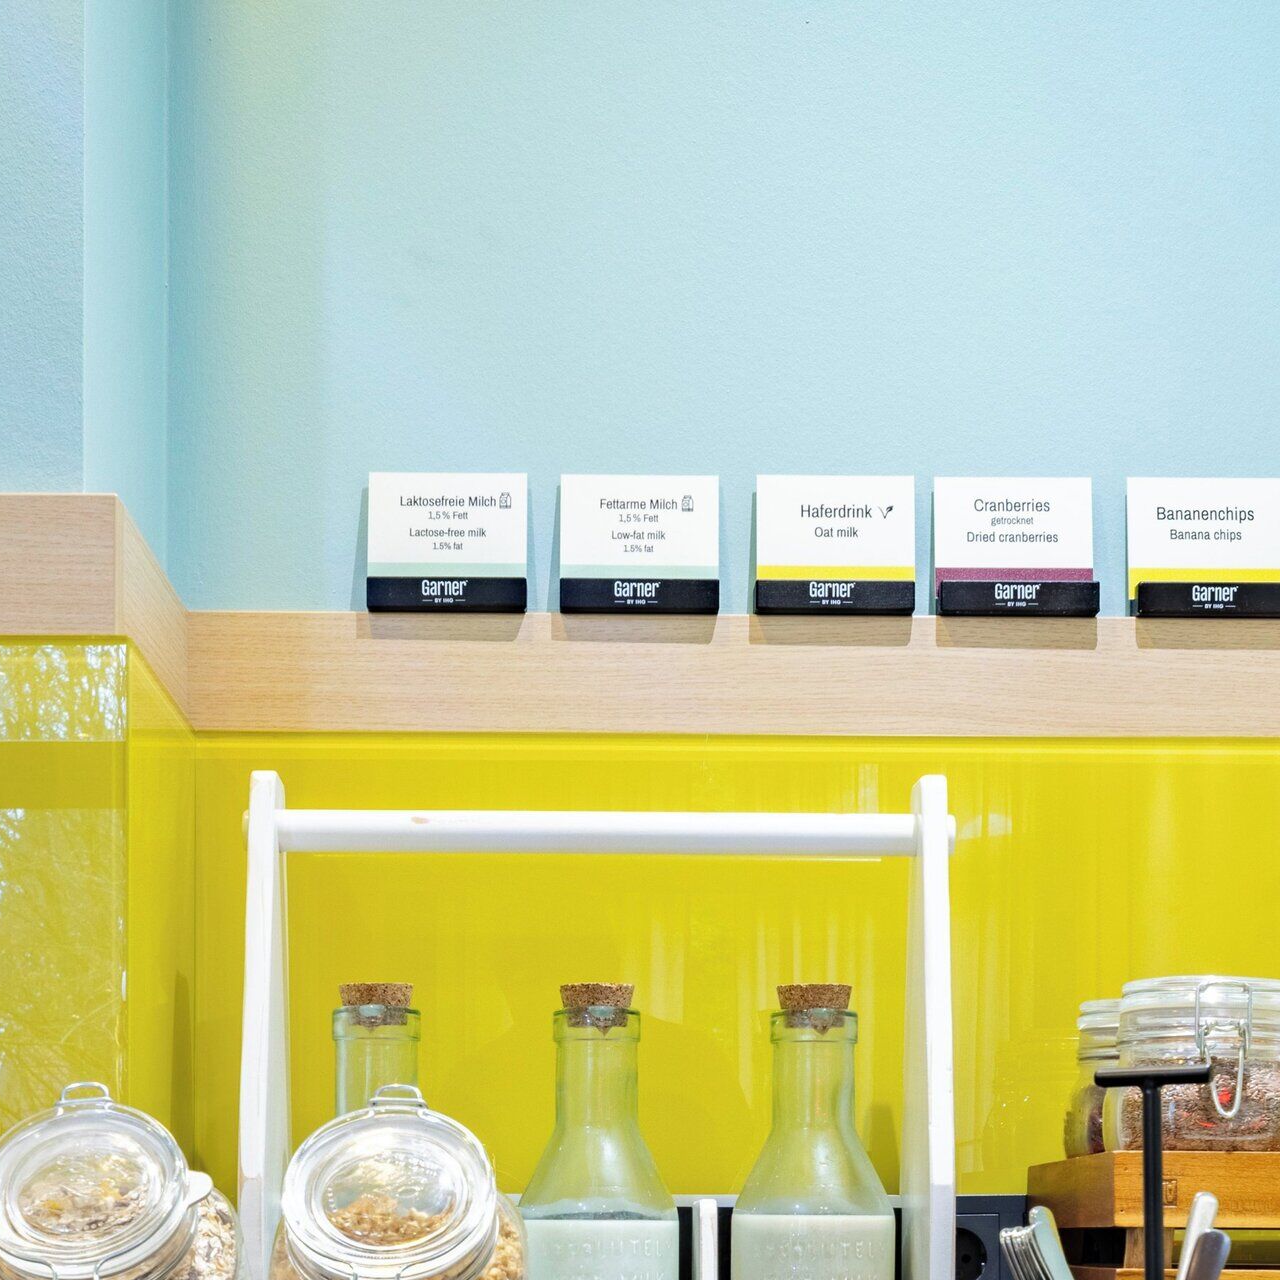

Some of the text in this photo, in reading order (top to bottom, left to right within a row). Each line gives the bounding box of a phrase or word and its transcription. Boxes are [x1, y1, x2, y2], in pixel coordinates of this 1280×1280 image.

[400, 496, 497, 507] Laktosefreie Milch
[600, 498, 678, 510] Fettarme Milch
[974, 498, 1051, 512] Cranberries
[453, 511, 468, 520] Fett
[800, 504, 872, 518] Haferdrink
[1157, 506, 1255, 524] Bananenchips
[643, 514, 659, 523] Fett
[991, 516, 1034, 527] getrocknet
[409, 528, 487, 537] Lactose-free milk
[611, 530, 666, 540] Low-fat milk
[814, 527, 859, 538] Oat milk
[967, 531, 1059, 543] Dried cranberries
[1170, 529, 1242, 542] Banana chips
[453, 542, 463, 550] fat
[644, 545, 654, 553] fat
